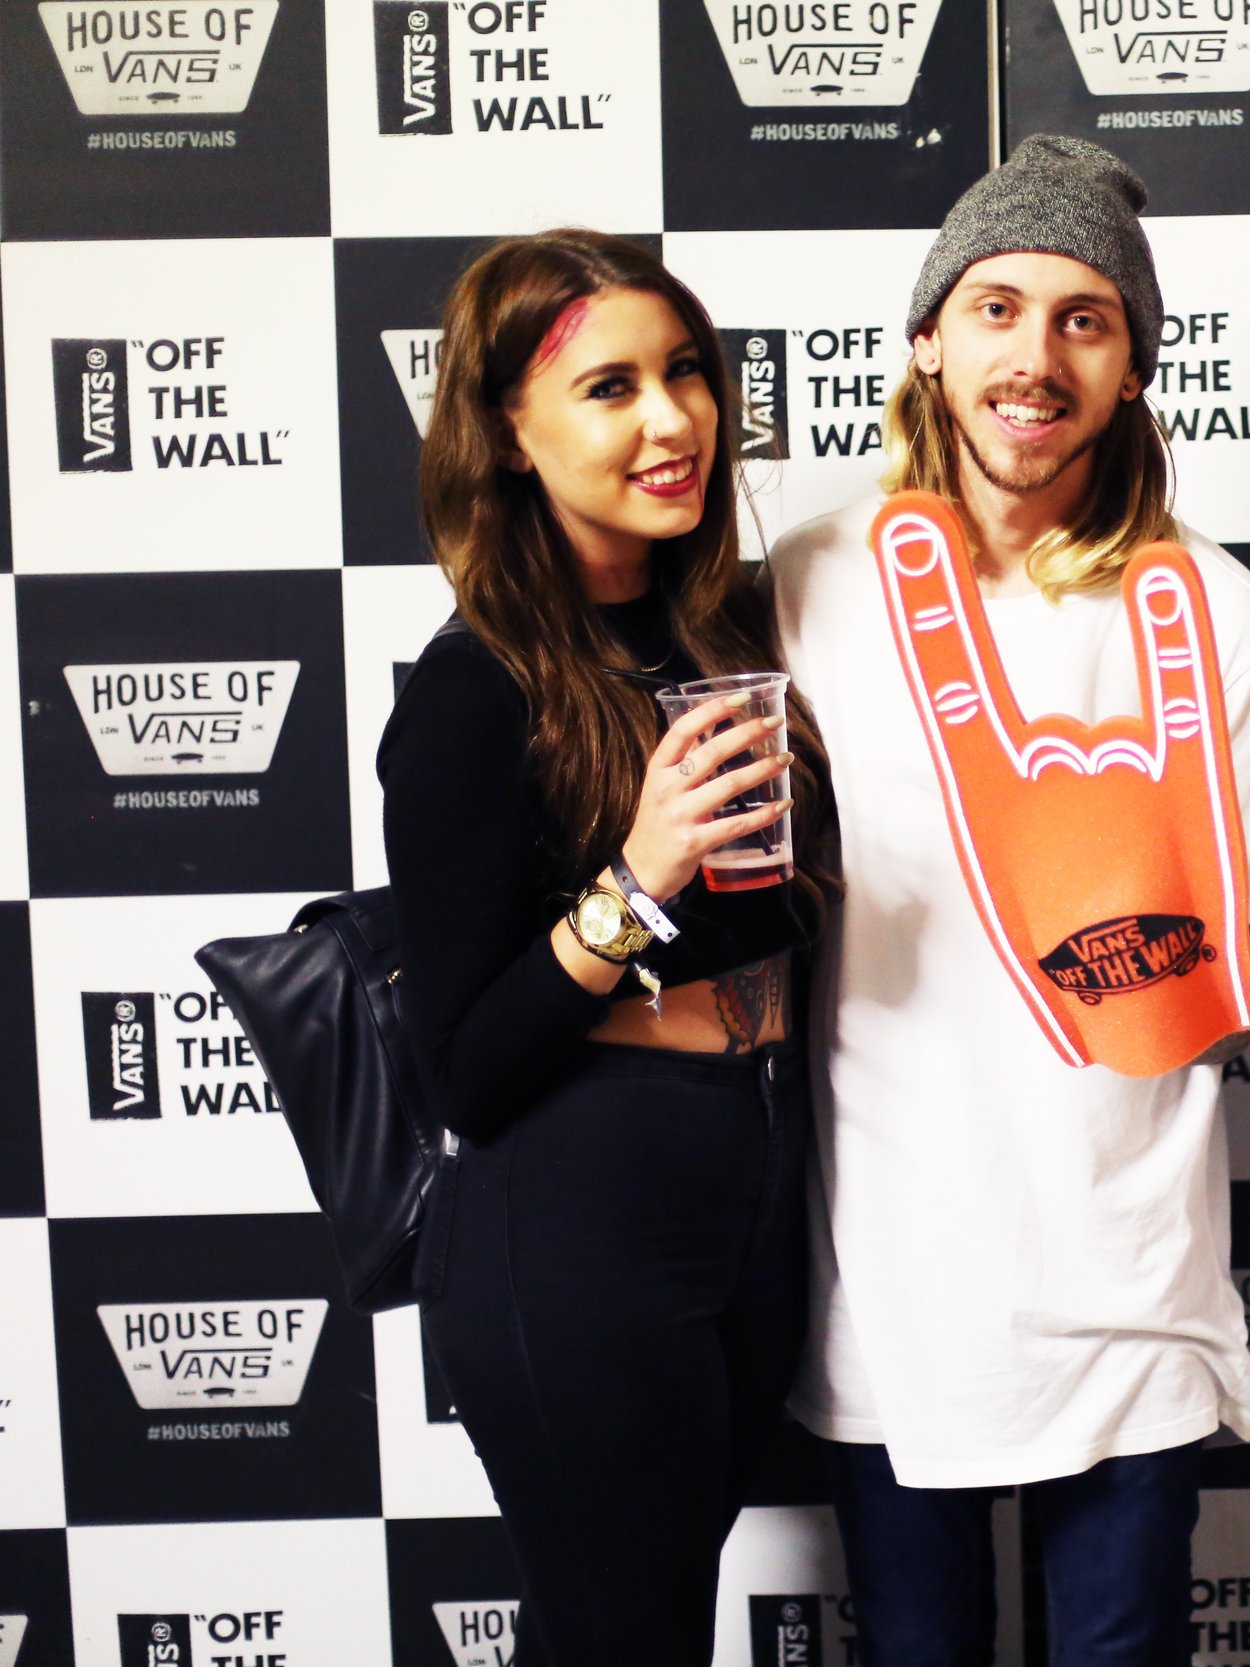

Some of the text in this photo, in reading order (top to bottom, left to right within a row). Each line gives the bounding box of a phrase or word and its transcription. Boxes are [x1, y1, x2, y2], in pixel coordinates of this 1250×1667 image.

[67, 8, 254, 51] HOUSE OF
[732, 2, 917, 44] HOUSE OF
[1080, 0, 1198, 34] HOUSE
[767, 43, 884, 76] VANS
[1113, 30, 1228, 64] VANS
[102, 49, 221, 84] VANS
[469, 48, 549, 83] THE
[750, 122, 899, 142] #HOUSEOFVANS
[1097, 108, 1244, 129] #HOUSEOFVANS
[87, 130, 237, 150] #HOUSEOFVANS
[808, 375, 884, 408] THE
[1158, 360, 1232, 394] THE
[148, 385, 228, 420] THE
[92, 671, 275, 714] HOUSE OF
[127, 711, 243, 744] VANS
[113, 789, 260, 809] #HOUSEOFVANS
[1067, 918, 1145, 963] VANS
[1088, 949, 1146, 987] THE
[176, 1036, 254, 1069] THE
[125, 1309, 305, 1351] HOUSE OF
[160, 1348, 273, 1380] VANS
[147, 1421, 290, 1440] #HOUSEOFVANS
